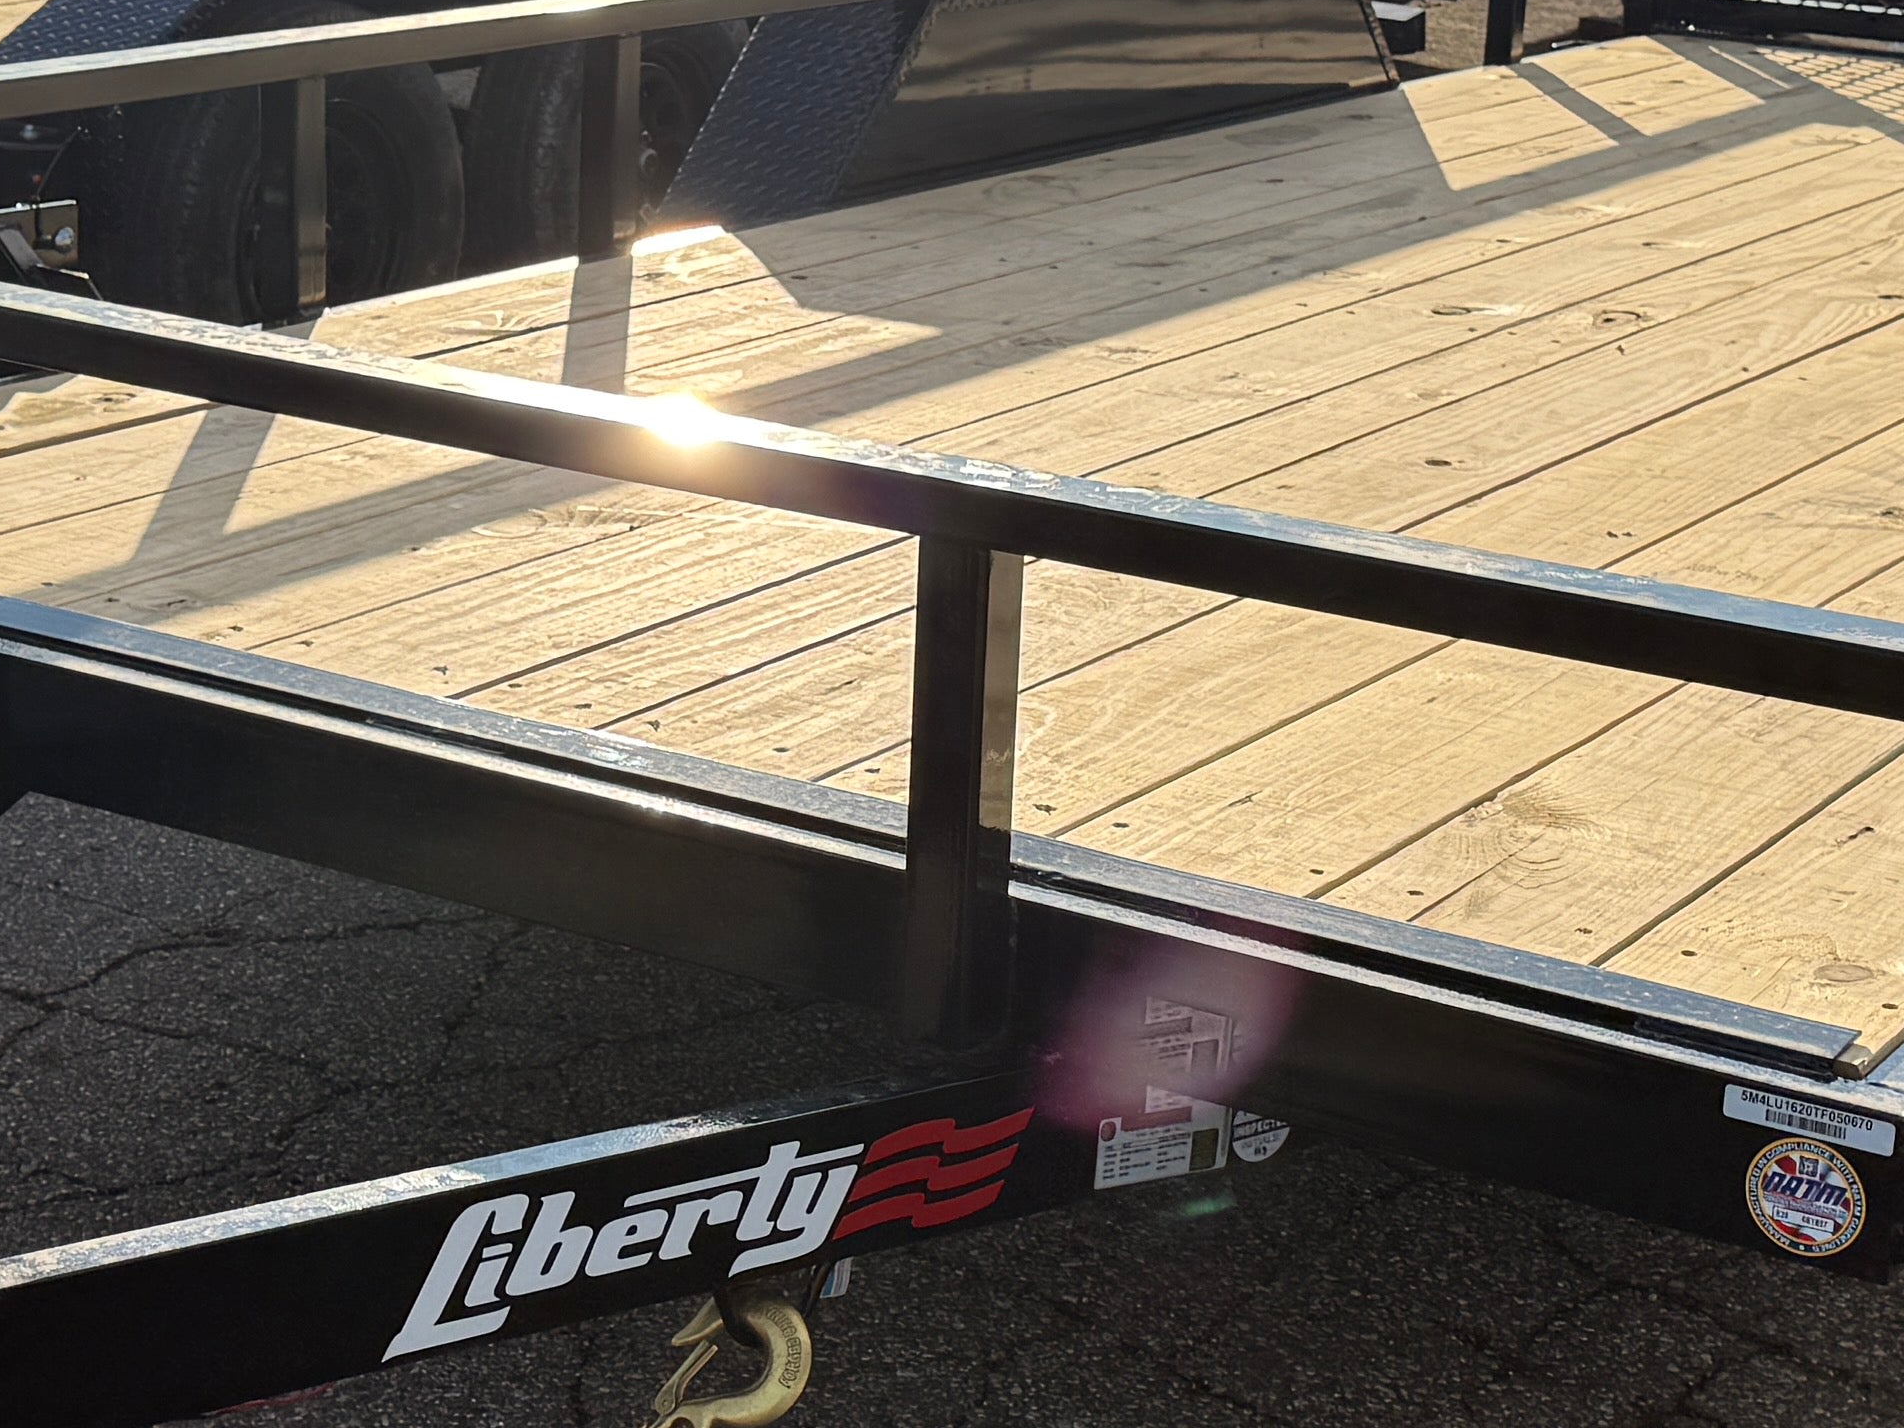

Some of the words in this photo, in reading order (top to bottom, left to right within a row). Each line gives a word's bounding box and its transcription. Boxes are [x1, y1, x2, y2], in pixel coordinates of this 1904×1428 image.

[1741, 1089, 1874, 1132] 5M4LU1620TF050670
[1765, 1142, 1832, 1160] COMPLIANCE
[1832, 1157, 1855, 1184] WITH
[381, 1140, 864, 1363] Liberty
